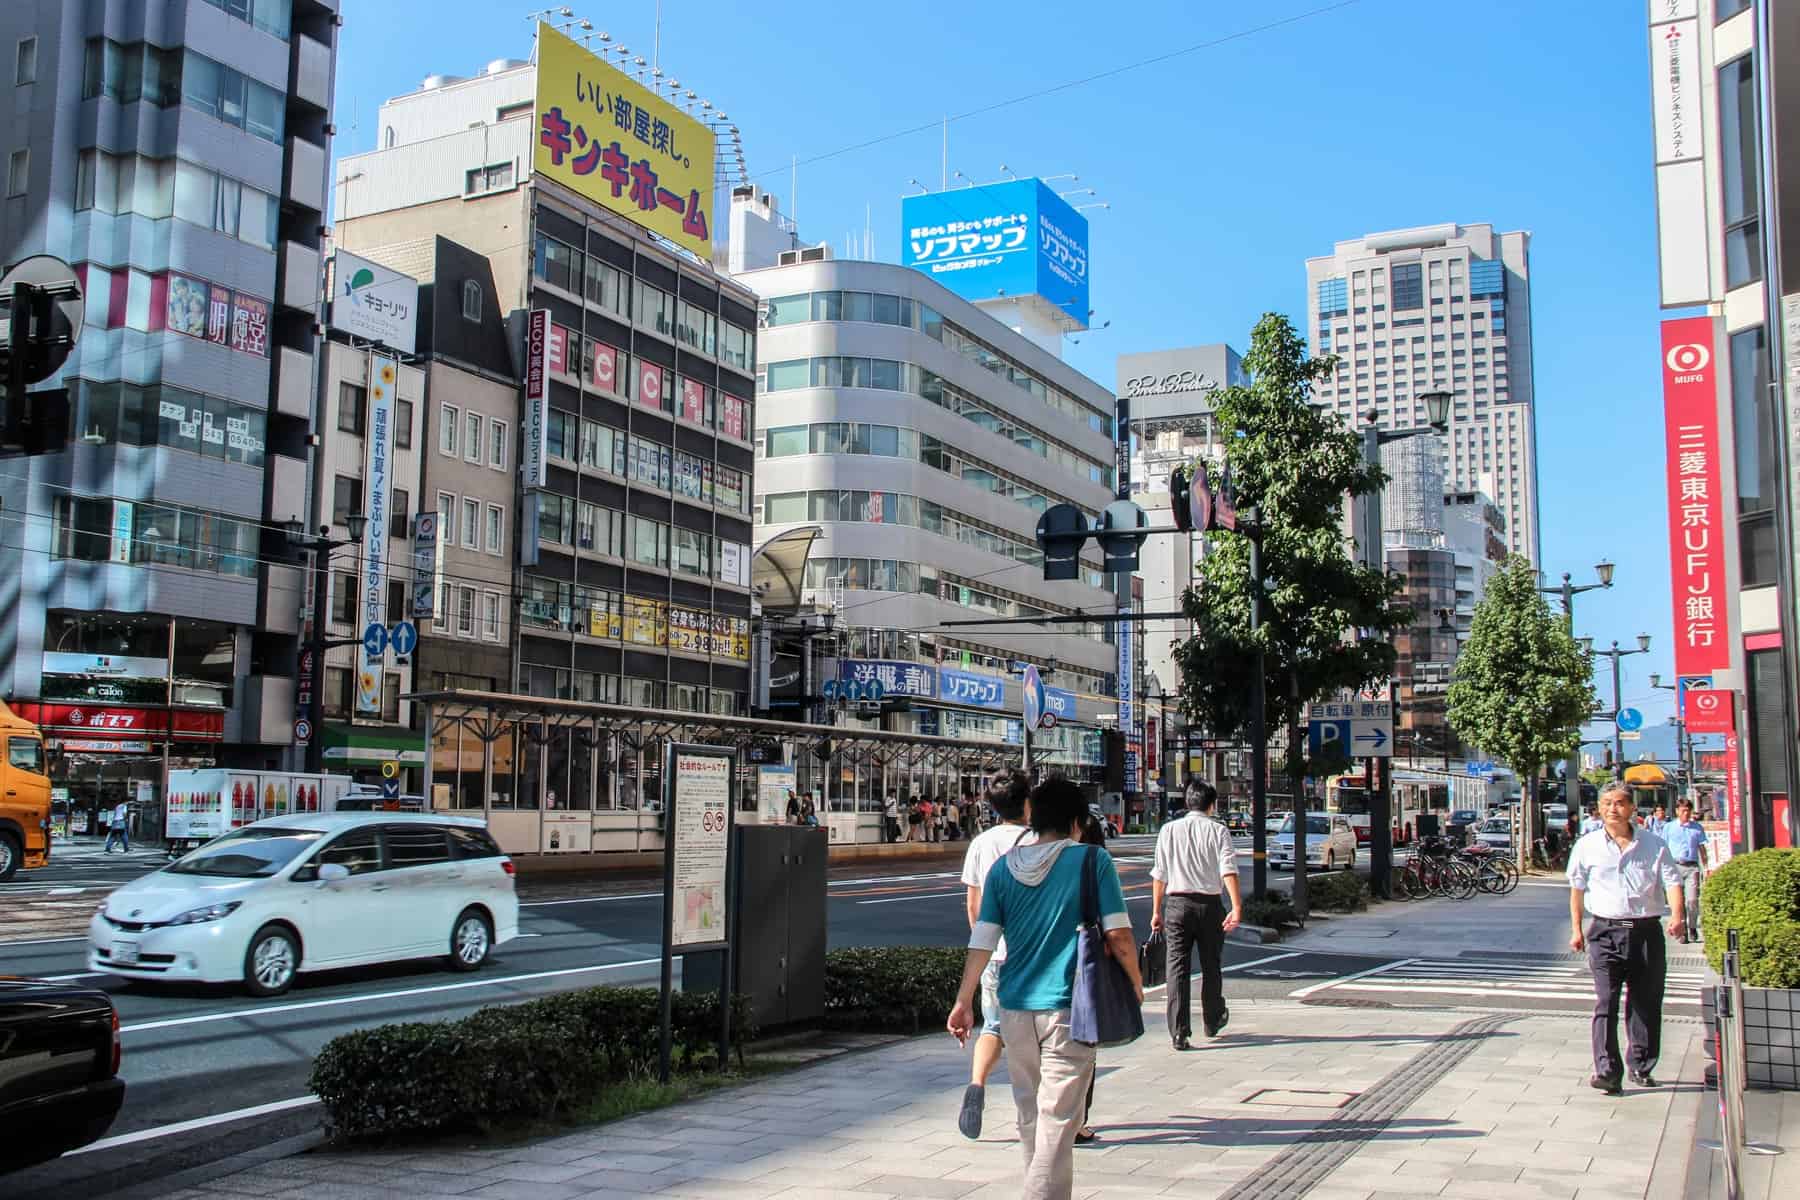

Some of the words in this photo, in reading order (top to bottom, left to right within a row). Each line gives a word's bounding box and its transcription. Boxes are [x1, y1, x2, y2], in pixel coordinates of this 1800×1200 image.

[576, 72, 690, 169] いい部屋探し。
[540, 106, 709, 241] キンキホーム
[911, 224, 1028, 260] ソフマップ
[1040, 229, 1087, 277] ソフマップ
[364, 291, 408, 320] キョーリツ
[1674, 374, 1704, 385] MUFG
[1679, 425, 1715, 647] 三菱東京UFJ銀行
[853, 664, 931, 696] 洋服の青山
[949, 676, 997, 701] ソフマップ
[1320, 722, 1340, 746] P
